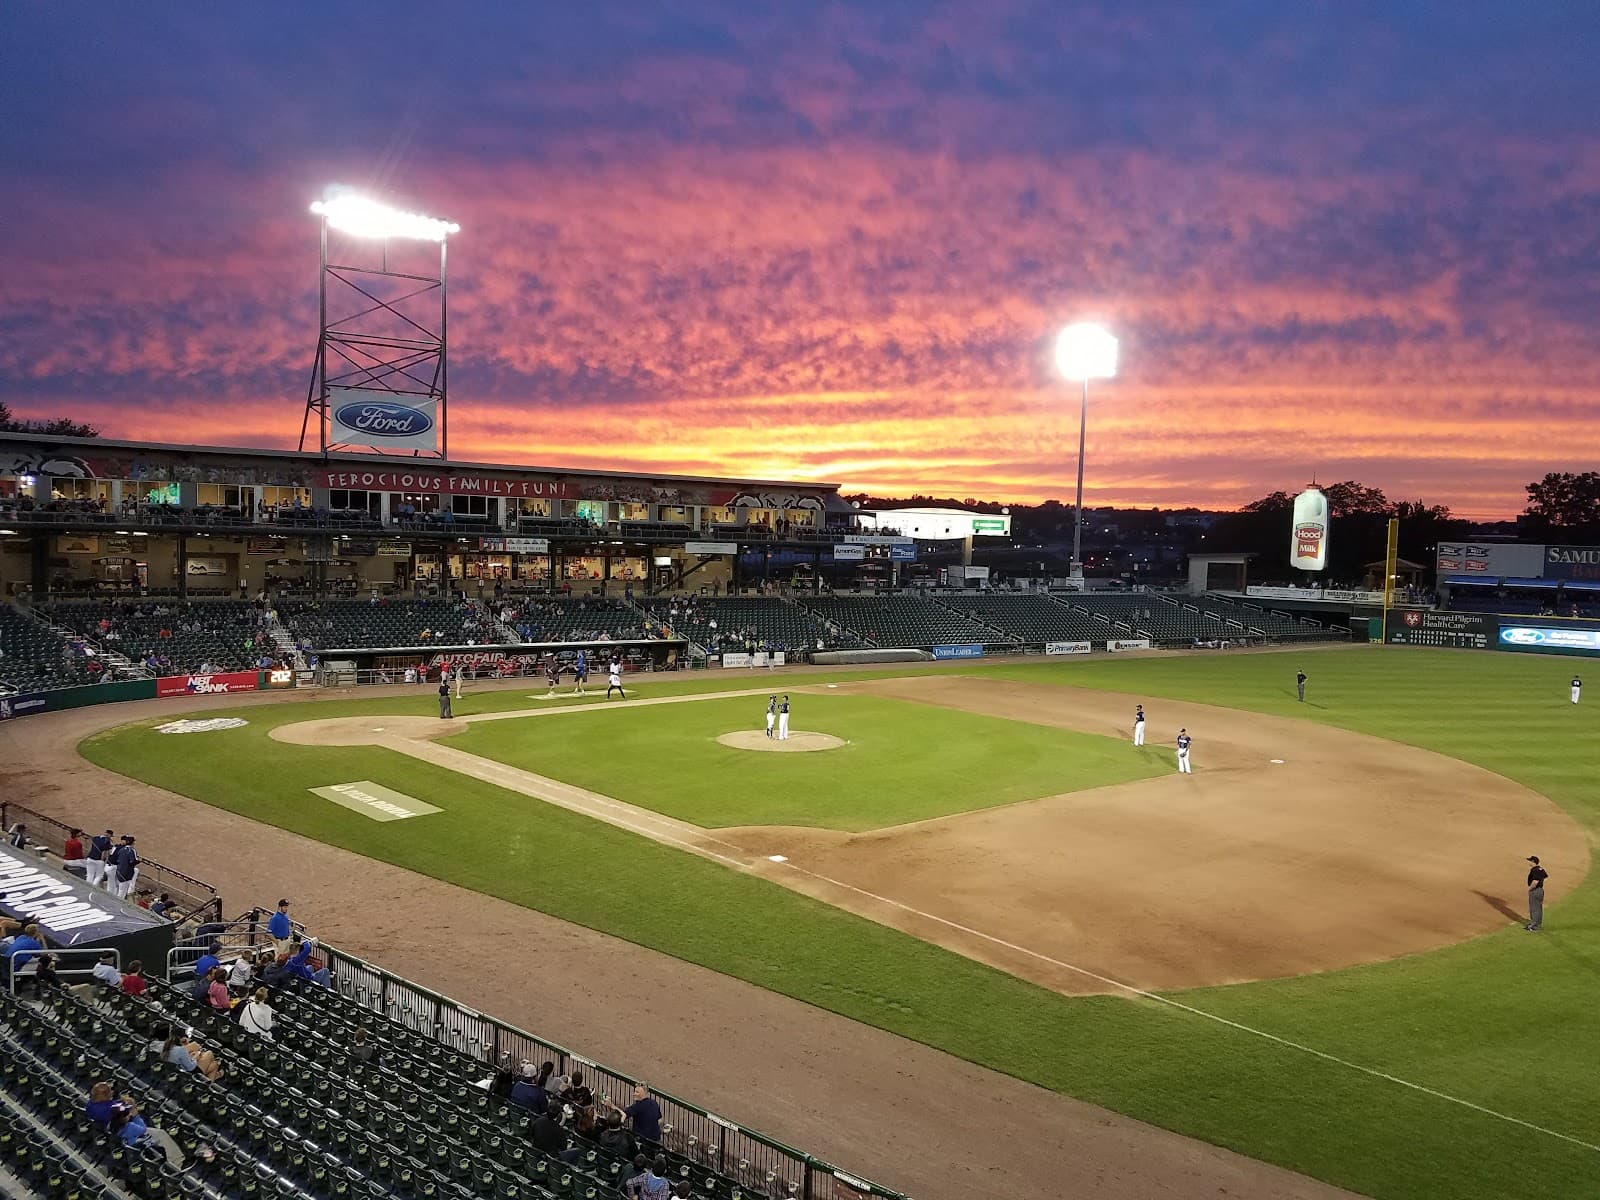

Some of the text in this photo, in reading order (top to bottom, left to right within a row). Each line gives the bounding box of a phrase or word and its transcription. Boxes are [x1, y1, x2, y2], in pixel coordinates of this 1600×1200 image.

[355, 406, 413, 433] Ford
[327, 473, 566, 496] FEROCIOUS FAMILY FUN!
[1297, 530, 1320, 539] Hood
[1300, 544, 1317, 553] Milk
[1422, 620, 1466, 629] Health Care
[1423, 613, 1483, 625] Harvard Pilgrim
[188, 675, 213, 686] NBT
